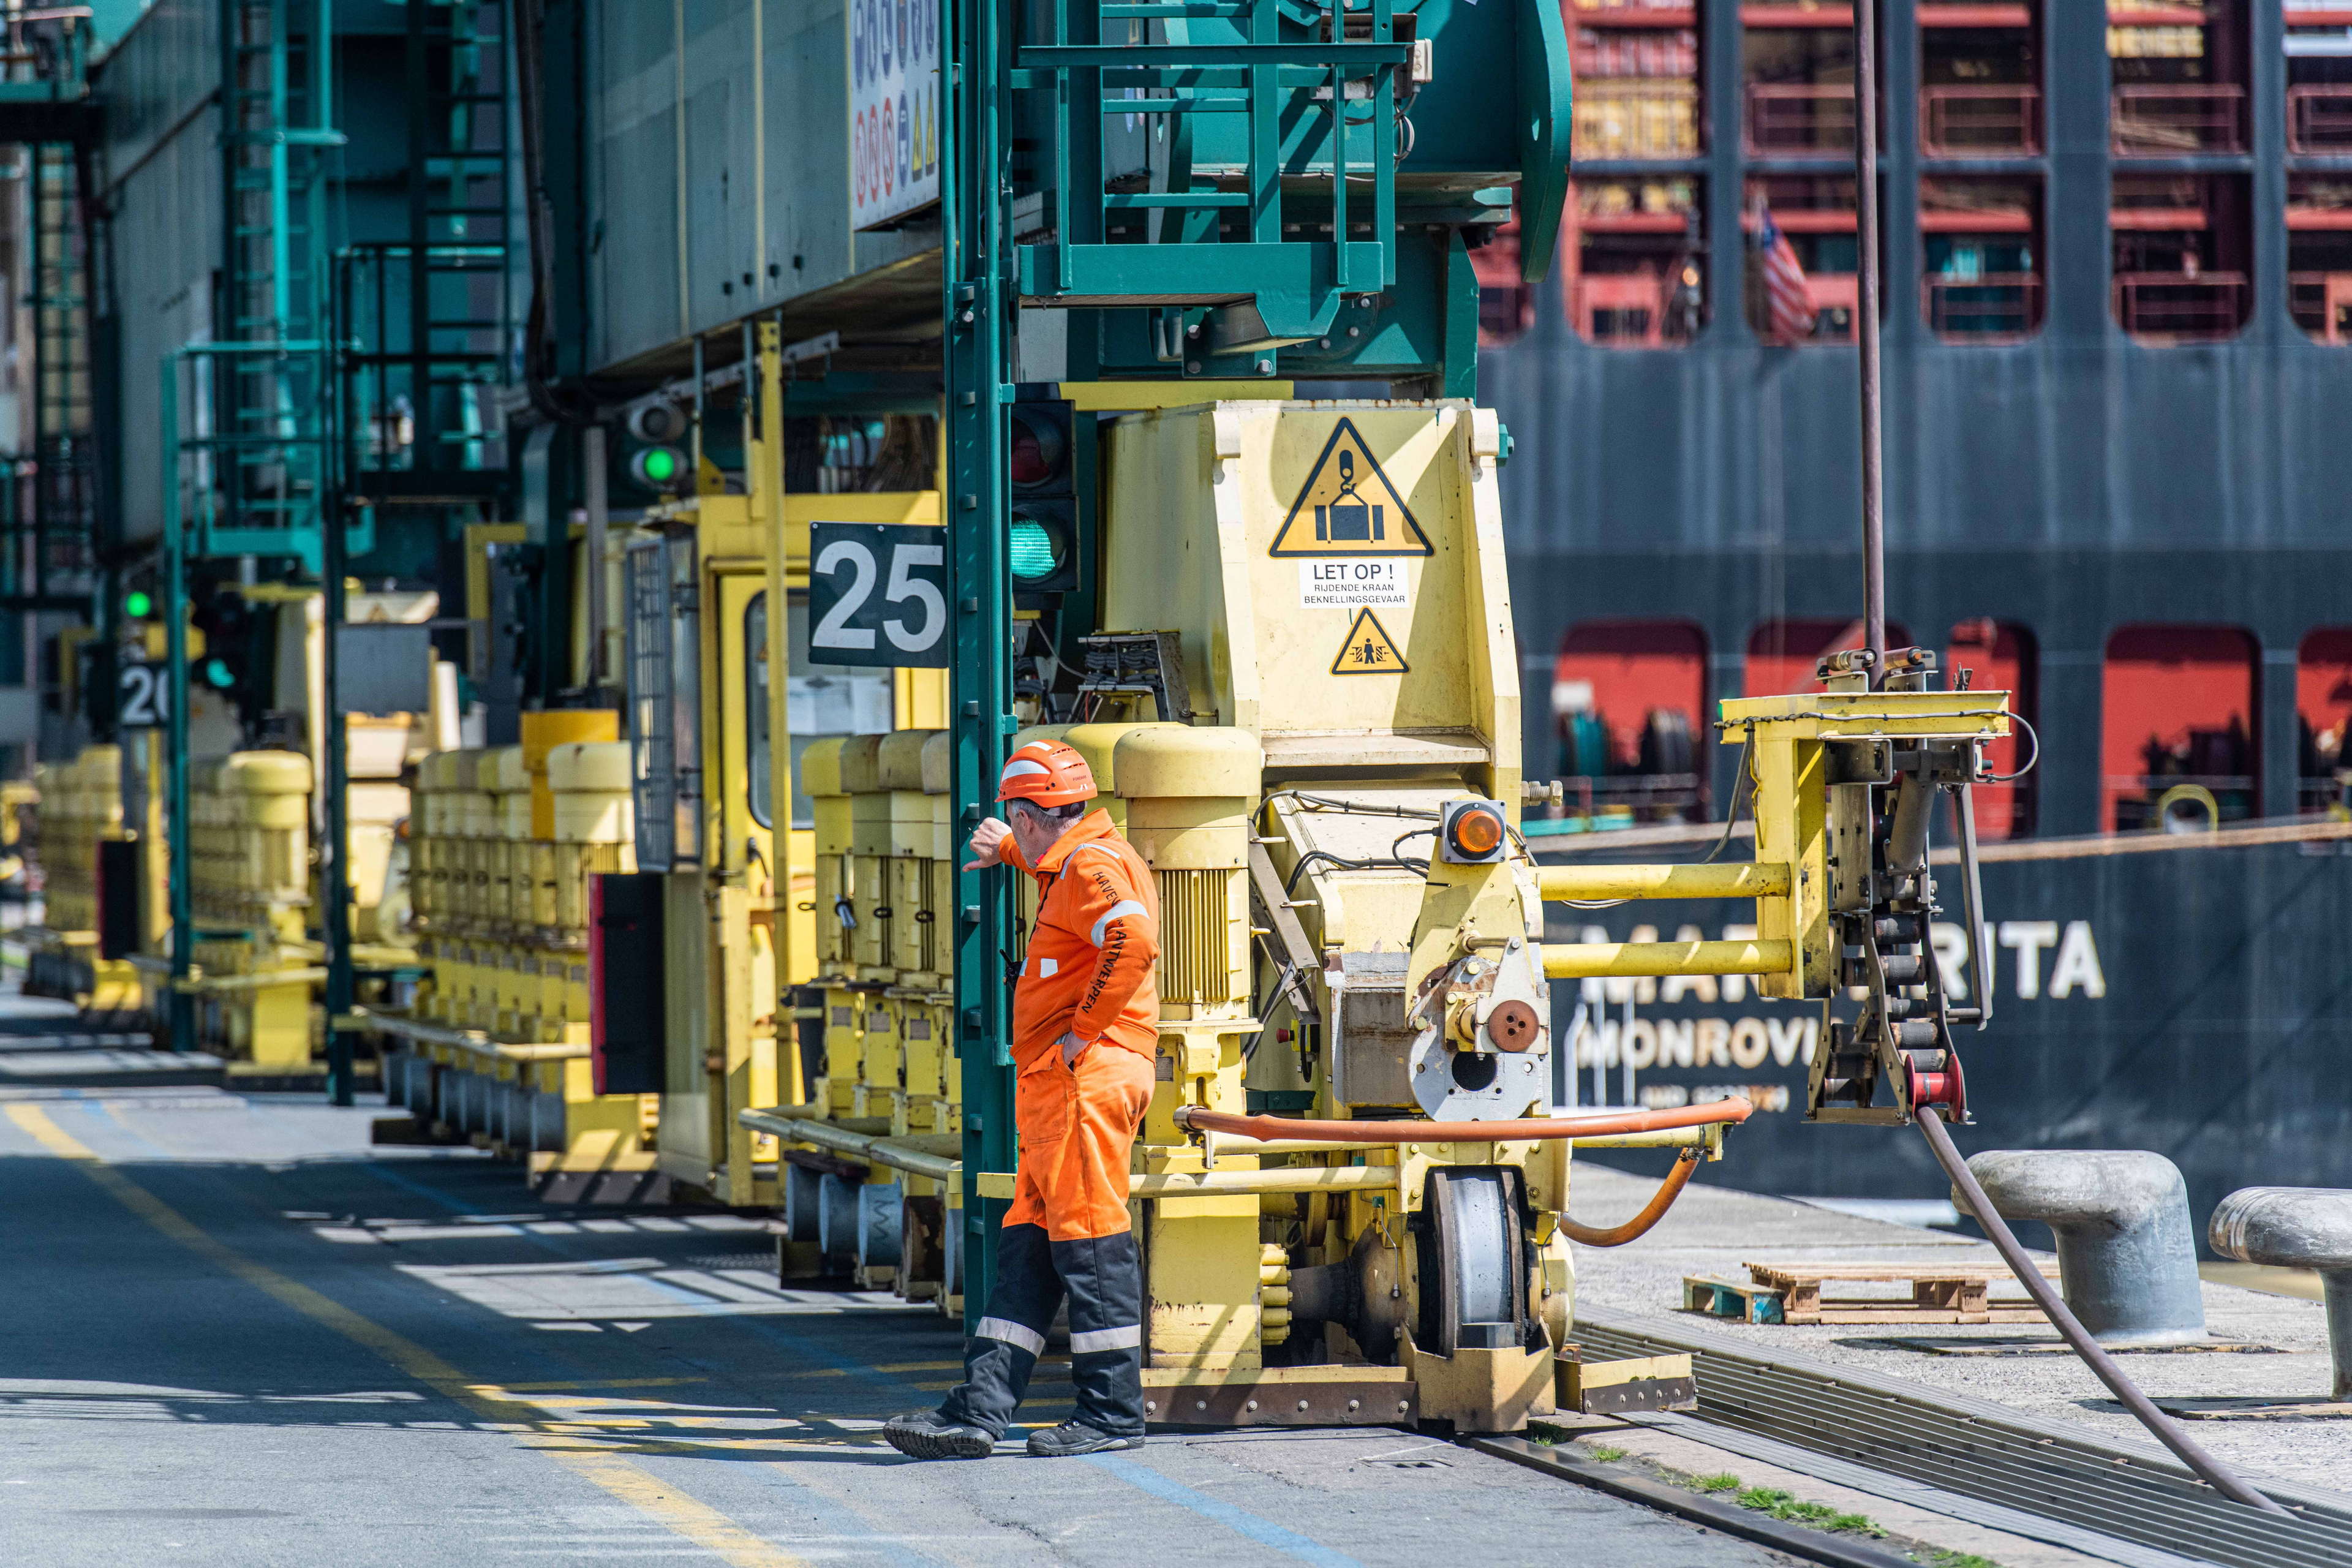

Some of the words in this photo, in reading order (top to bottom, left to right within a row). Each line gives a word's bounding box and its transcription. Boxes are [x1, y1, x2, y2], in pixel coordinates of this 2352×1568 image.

[812, 540, 946, 652] 25
[1314, 565, 1348, 579] LET
[1355, 564, 1381, 579] OP
[1092, 872, 1121, 907] HAVEN
[1081, 930, 1127, 1014] ANTWERPEN
[1576, 1016, 1844, 1071] MONROVI
